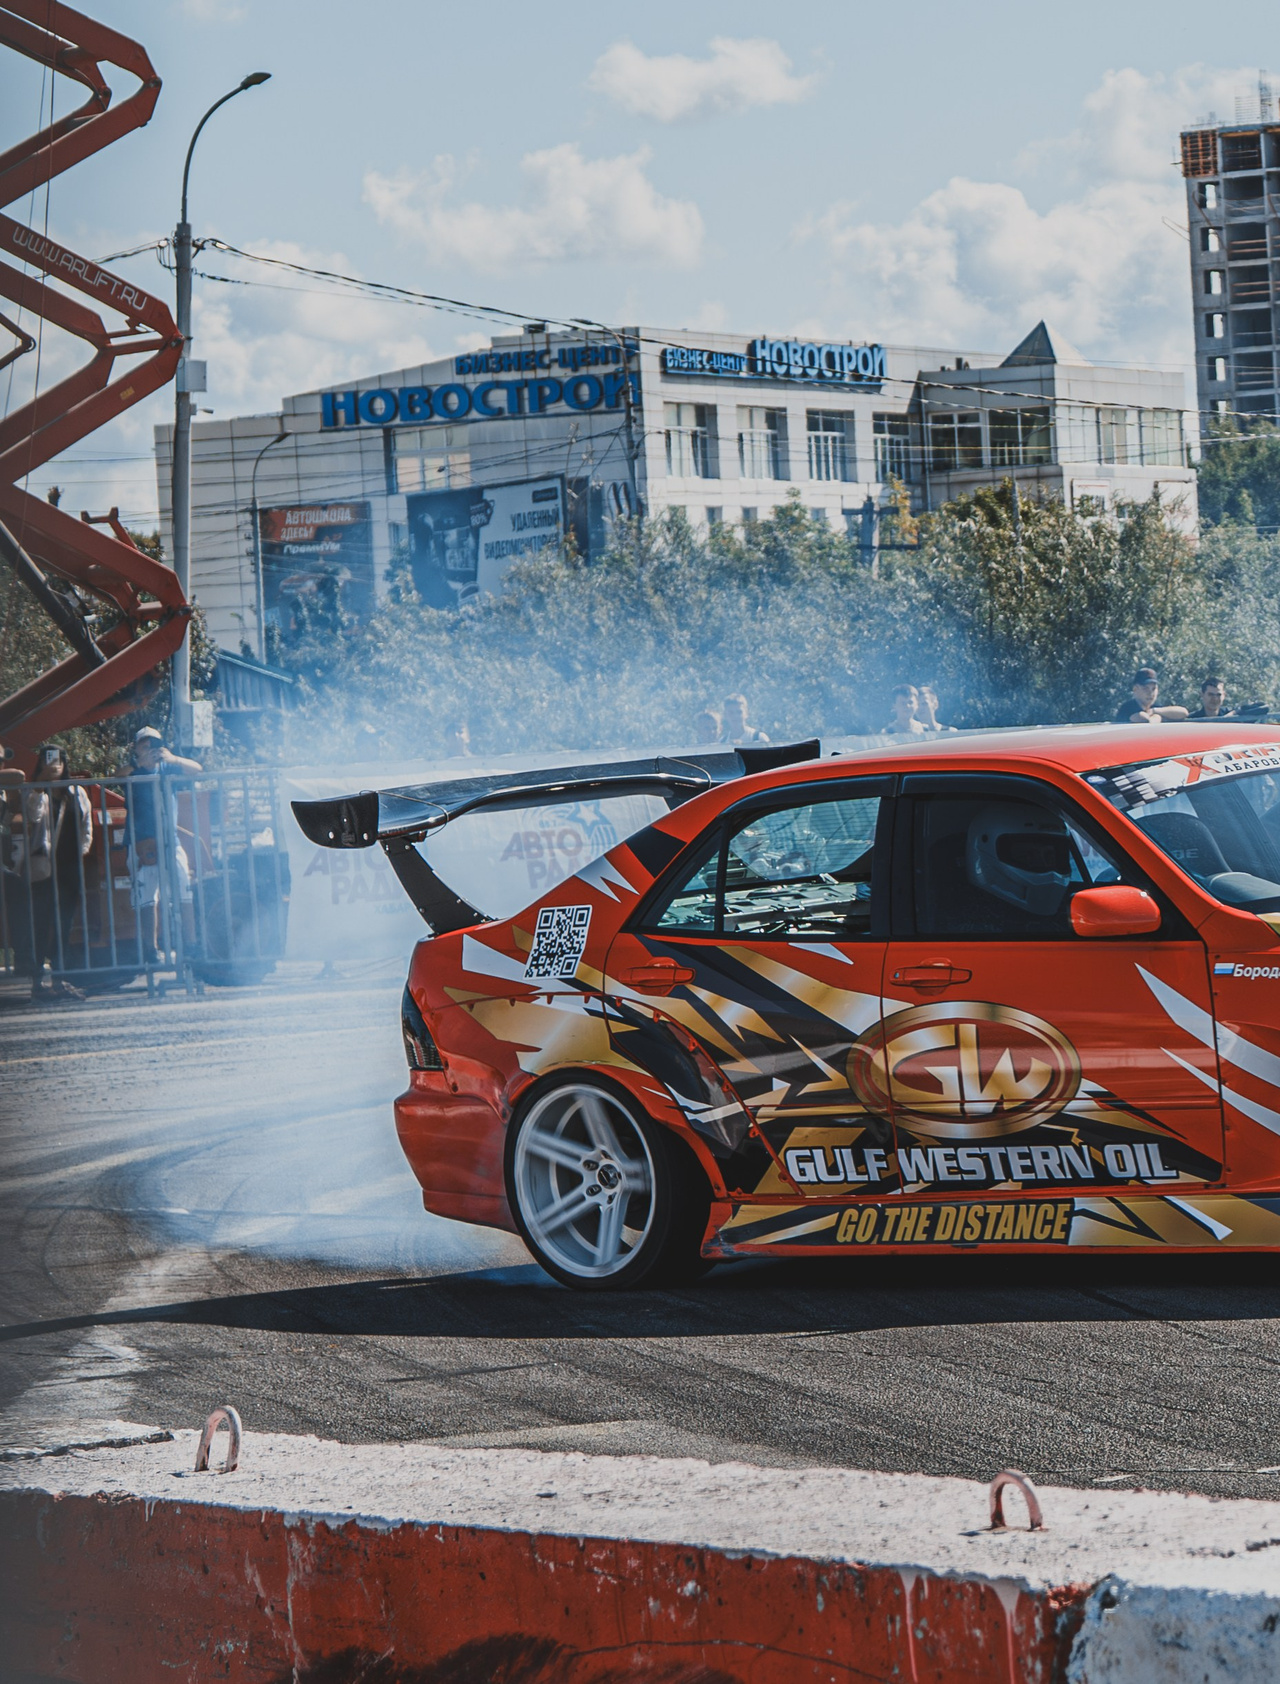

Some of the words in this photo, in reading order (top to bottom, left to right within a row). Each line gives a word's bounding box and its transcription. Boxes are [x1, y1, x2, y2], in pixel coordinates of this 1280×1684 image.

[13, 226, 147, 310] WWW.ARLIFT.RU
[455, 344, 637, 375] БИЗНЕС-ЦЕНТР
[755, 339, 887, 378] НОВОСТРОЙ
[321, 368, 639, 428] НОВОСТРОЙ
[499, 827, 583, 862] АВТО
[785, 1146, 889, 1182] GULF
[898, 1144, 1095, 1180] WESTERN
[1105, 1142, 1179, 1178] OIL
[836, 1207, 877, 1243] GO
[879, 1205, 932, 1242] THE
[933, 1203, 1072, 1242] DISTANCE
